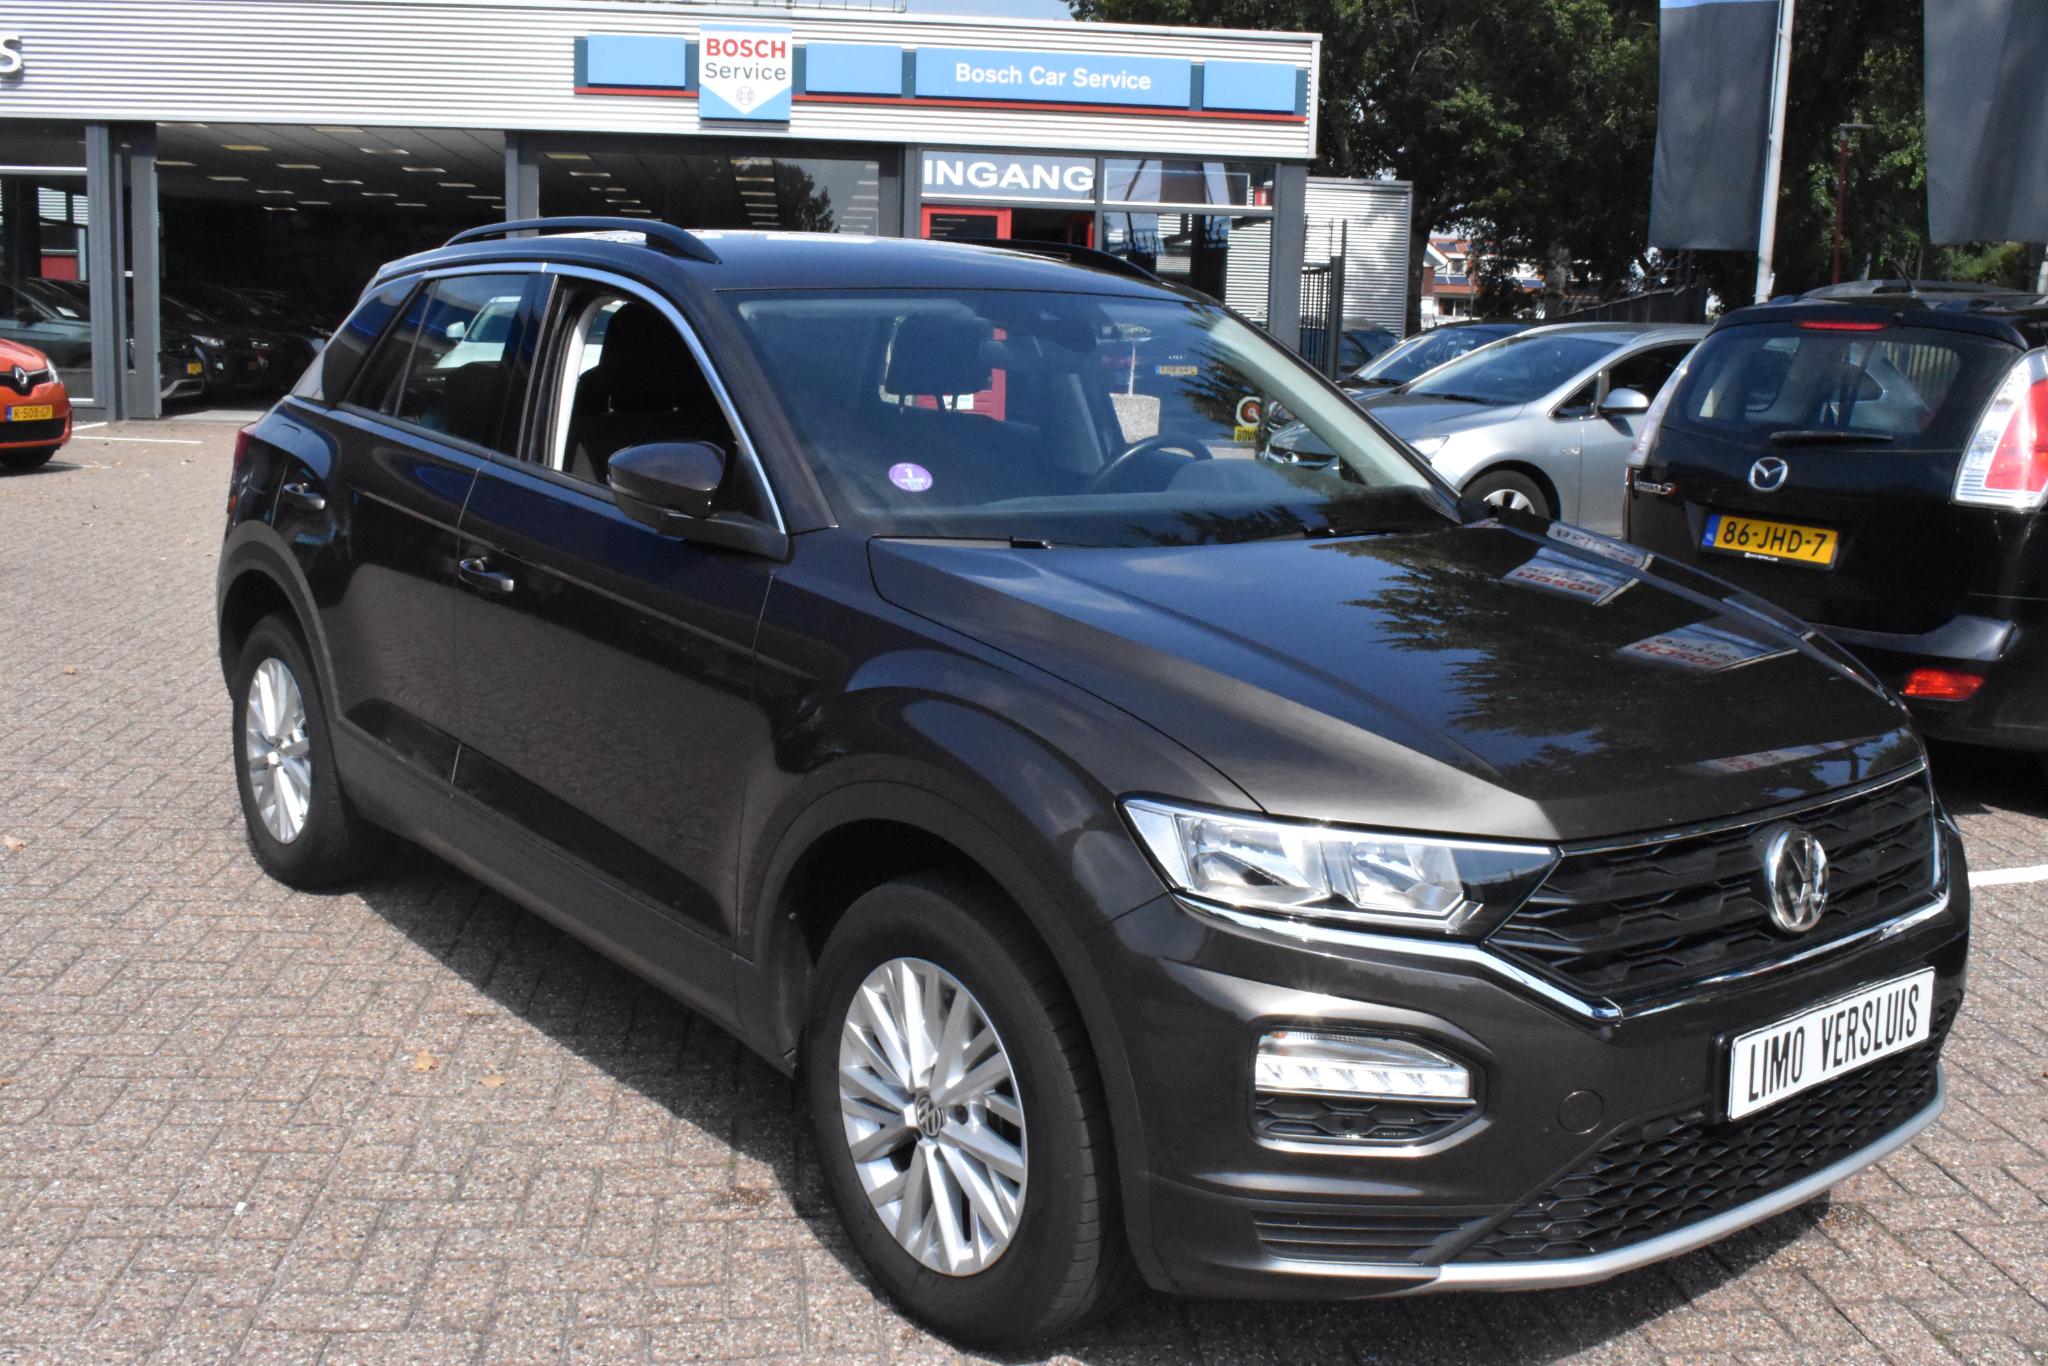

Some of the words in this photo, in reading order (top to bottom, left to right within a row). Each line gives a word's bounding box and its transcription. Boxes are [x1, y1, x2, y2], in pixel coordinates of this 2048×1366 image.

[706, 38, 786, 59] BOSCH
[705, 62, 786, 81] Service
[955, 63, 1022, 84] Bosch
[1029, 66, 1066, 87] Car
[1073, 68, 1152, 90] Service
[923, 159, 1095, 191] INGANG
[1723, 521, 1828, 557] 86-JHD-7
[1748, 1026, 1805, 1103] LIMO
[1821, 983, 1919, 1072] VERSLUIS
